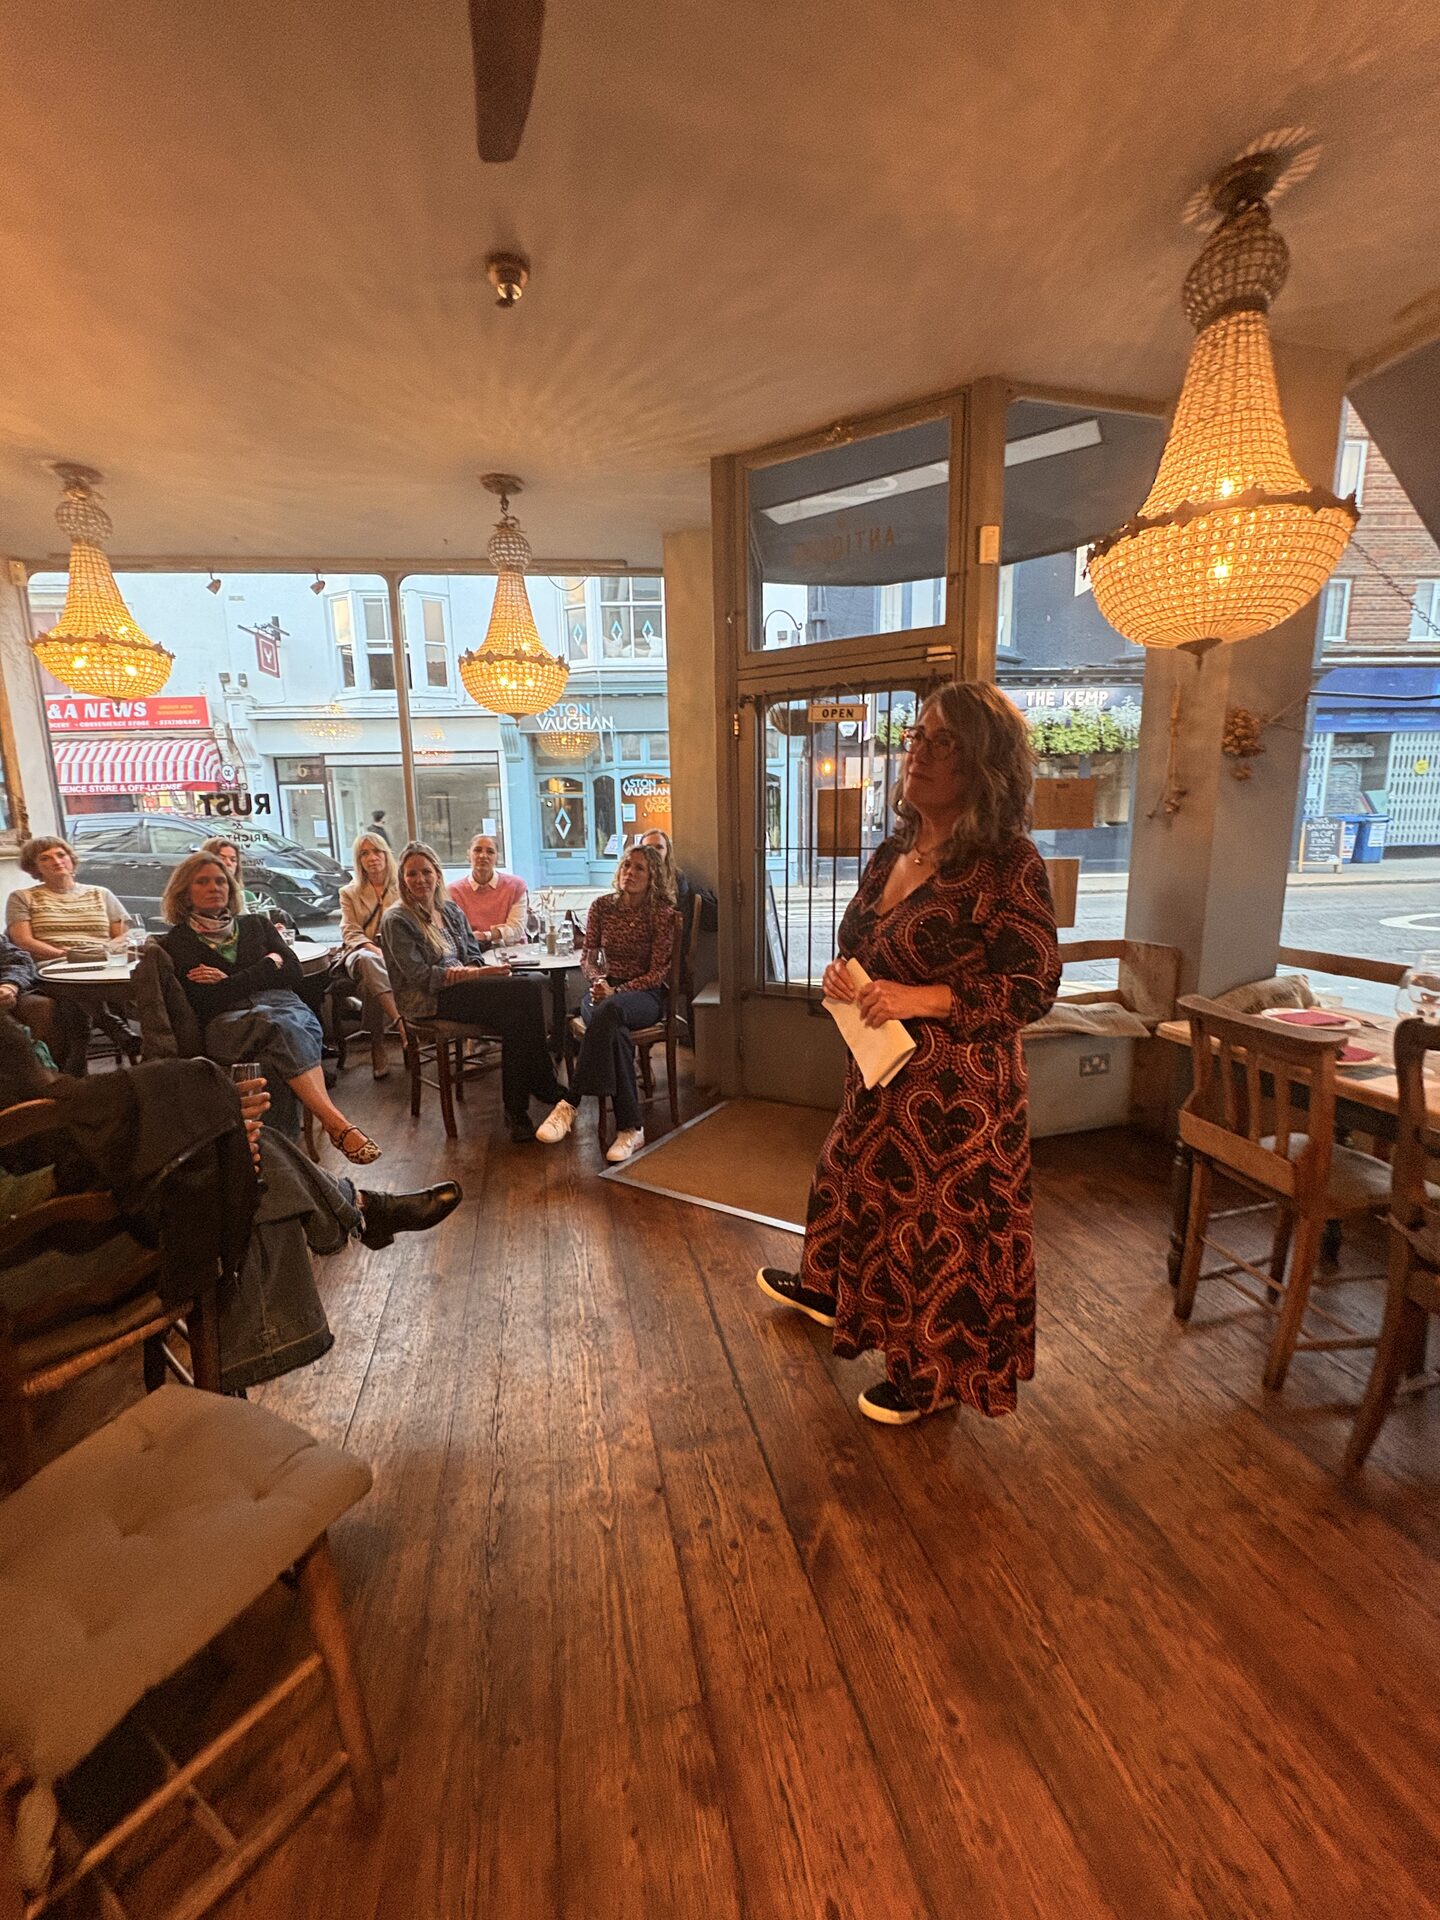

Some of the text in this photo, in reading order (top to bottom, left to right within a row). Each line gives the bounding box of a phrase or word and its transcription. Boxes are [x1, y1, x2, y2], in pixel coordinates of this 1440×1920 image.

[1025, 690, 1110, 707] THE KEMP
[84, 701, 148, 719] NEWS
[543, 703, 591, 717] STON
[822, 708, 854, 718] OPEN
[127, 719, 150, 727] STORE
[536, 715, 614, 731] VAUGHAN
[88, 784, 118, 793] STORE
[119, 784, 126, 792] &
[127, 783, 182, 792] OFF-LICENSE
[623, 779, 657, 790] ASTON
[623, 787, 670, 797] VAUGHAN
